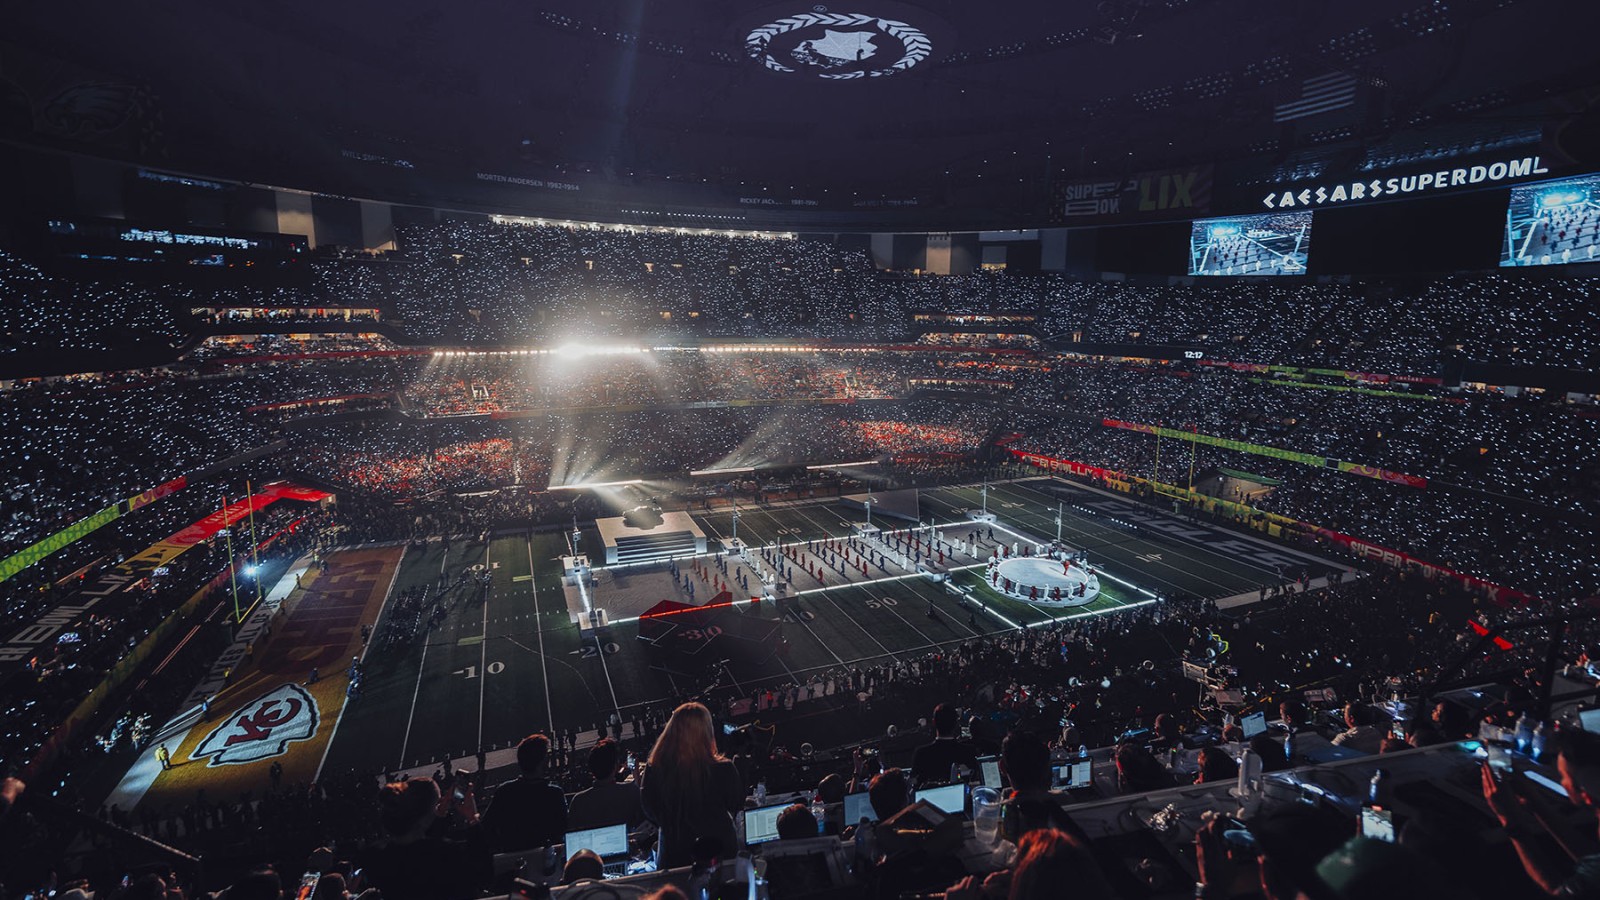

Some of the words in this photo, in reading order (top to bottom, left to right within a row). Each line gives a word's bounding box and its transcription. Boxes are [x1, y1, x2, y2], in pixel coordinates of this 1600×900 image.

[477, 172, 507, 182] MORTEN
[508, 177, 543, 187] ANDERSEN
[1138, 172, 1198, 212] LIX
[1263, 180, 1383, 209] CAESARS
[865, 596, 899, 610] 50
[8, 598, 102, 644] BOWL
[581, 642, 621, 660] 20
[464, 661, 506, 680] 10
[223, 698, 302, 747] KC
